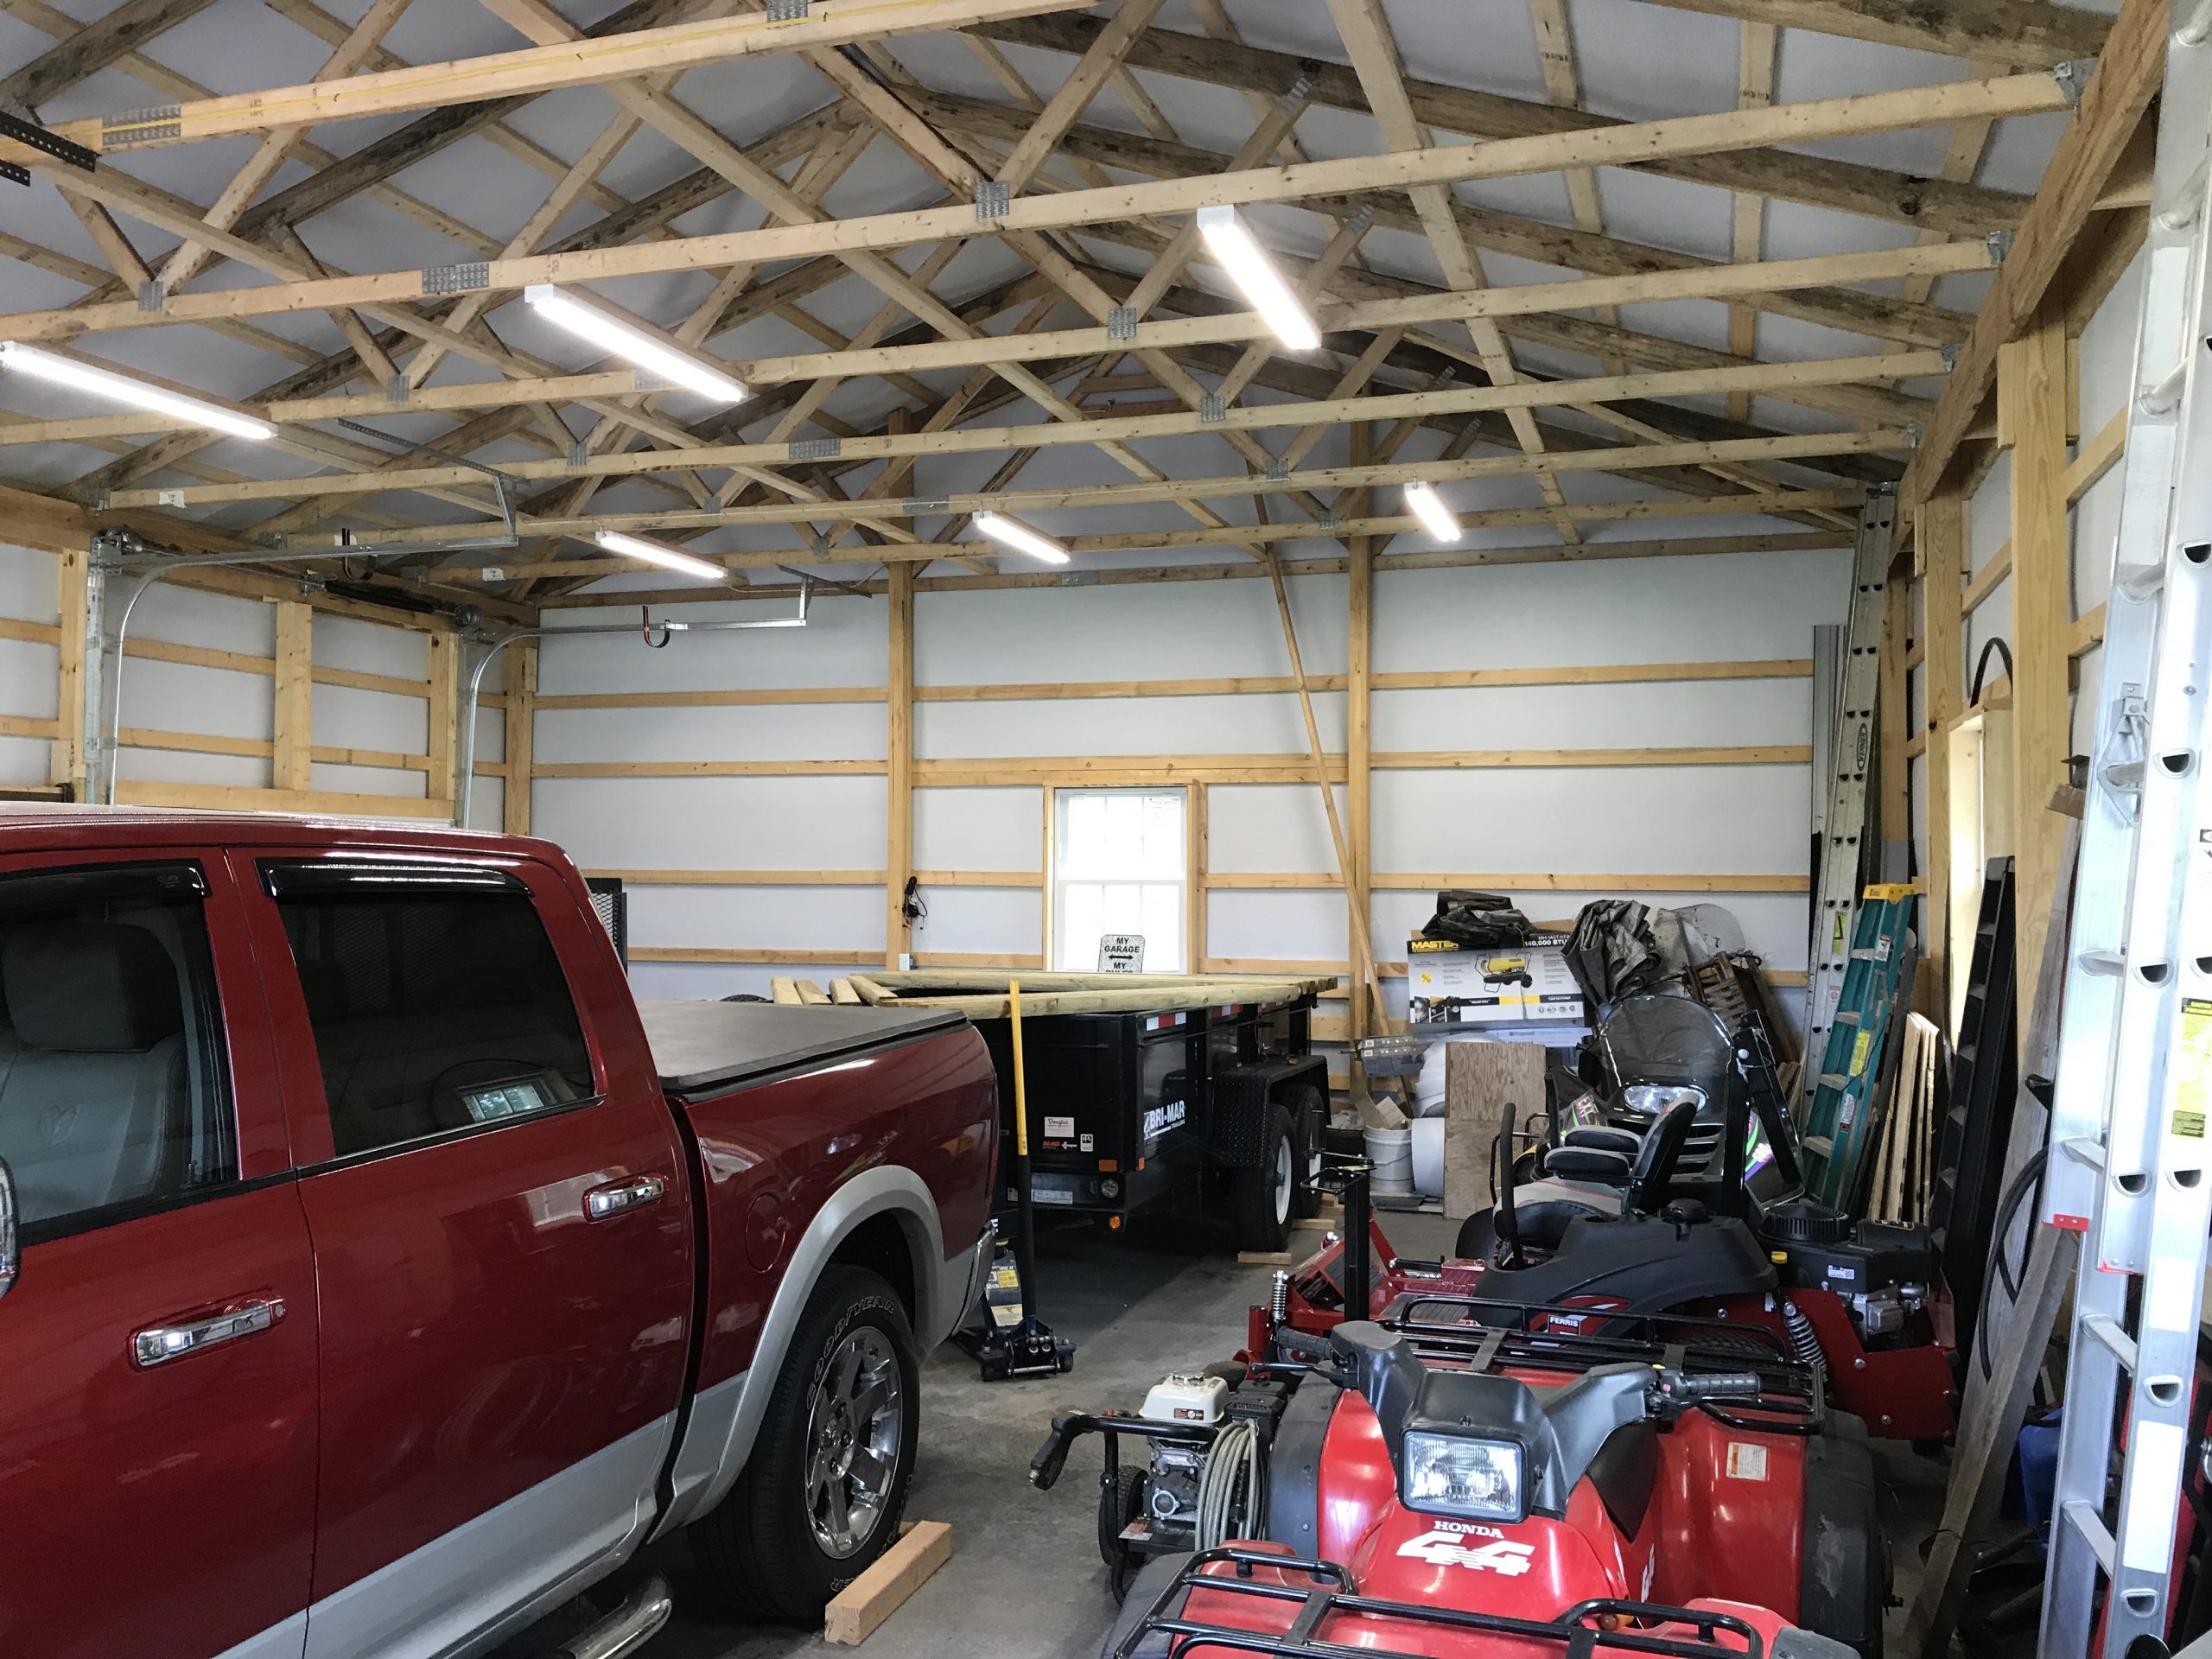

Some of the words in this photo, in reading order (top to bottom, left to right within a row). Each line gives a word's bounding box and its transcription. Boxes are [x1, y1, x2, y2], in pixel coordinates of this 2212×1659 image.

[1149, 1100, 1185, 1129] BRI-MAR
[1550, 1316, 1579, 1327] FERRIS
[807, 1296, 895, 1410] GOODYEAR
[1433, 1521, 1504, 1539] HONDA
